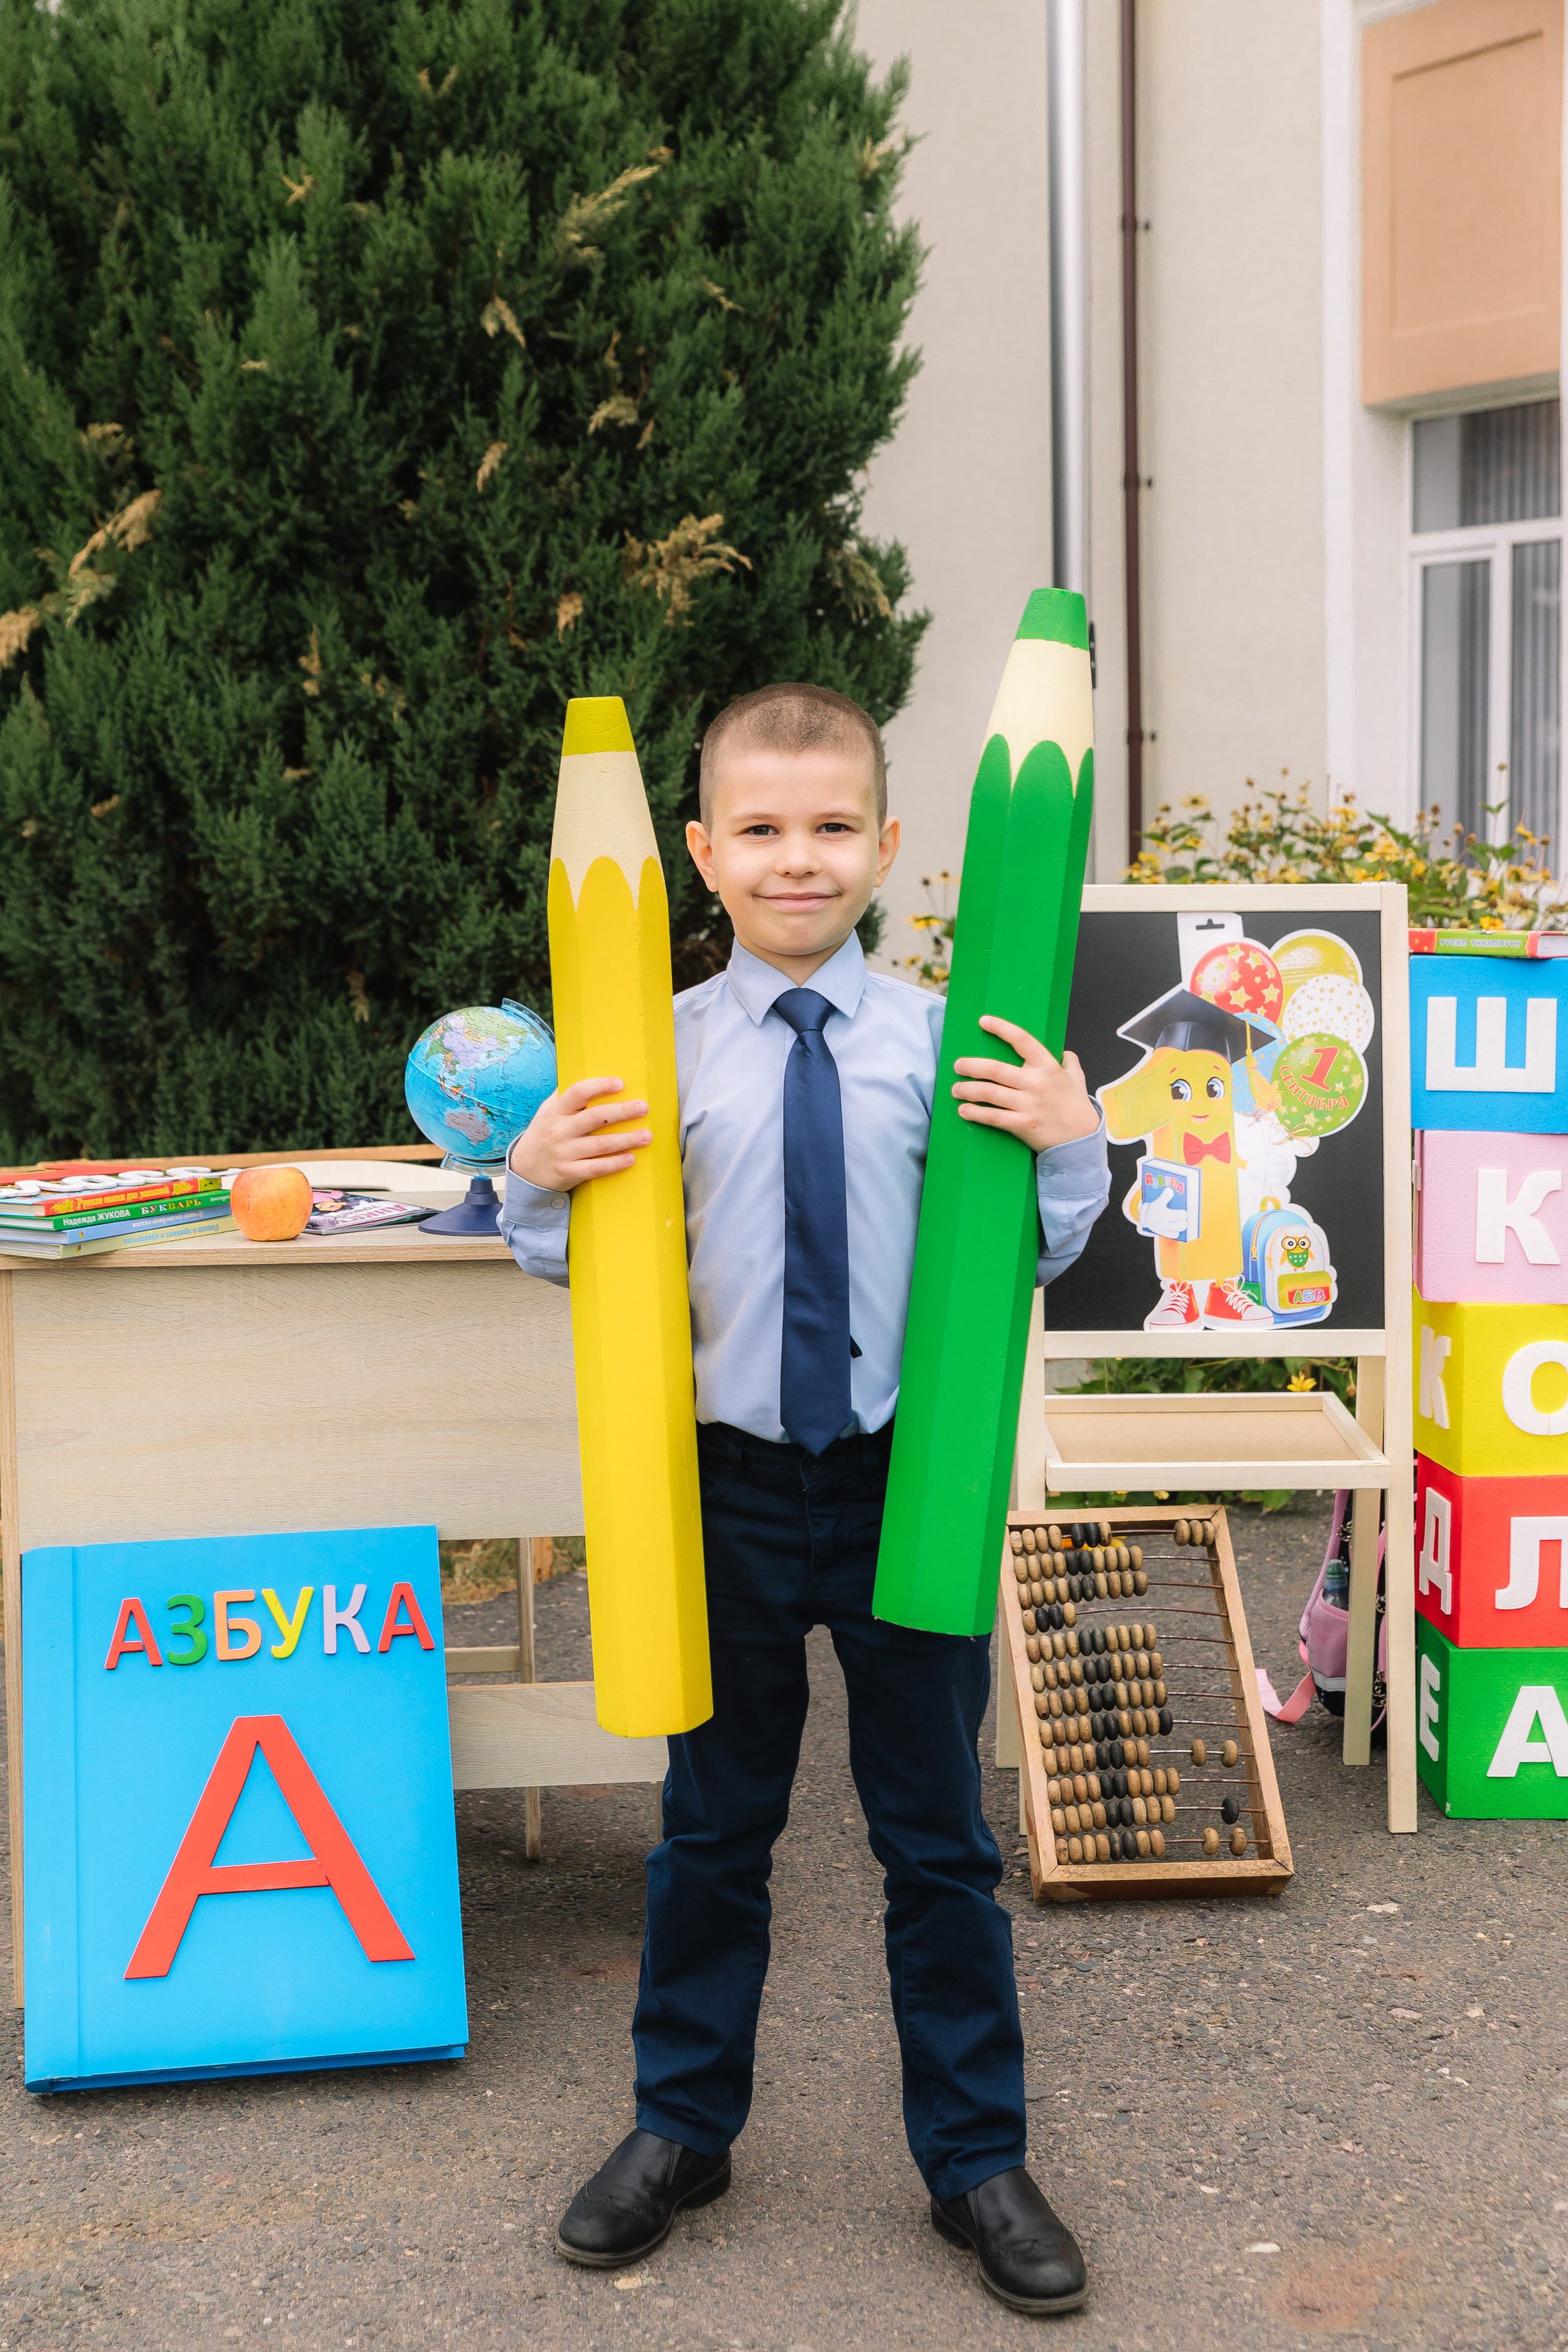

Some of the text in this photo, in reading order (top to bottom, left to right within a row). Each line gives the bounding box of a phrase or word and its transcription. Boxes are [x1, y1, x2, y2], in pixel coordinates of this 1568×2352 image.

[1439, 938, 1522, 948] МАЛЫШКИНА ШКОЛА
[1279, 1065, 1350, 1111] СЕНТЯБРЯ
[1300, 1046, 1340, 1092] 1
[62, 1215, 96, 1226] Надежда
[97, 1209, 131, 1221] ЖУКОВА
[141, 1199, 202, 1215] БУКВАРЬ
[1293, 1288, 1325, 1304] АБВ
[105, 1582, 435, 1670] АЗБУКА
[124, 1714, 416, 1980] А
